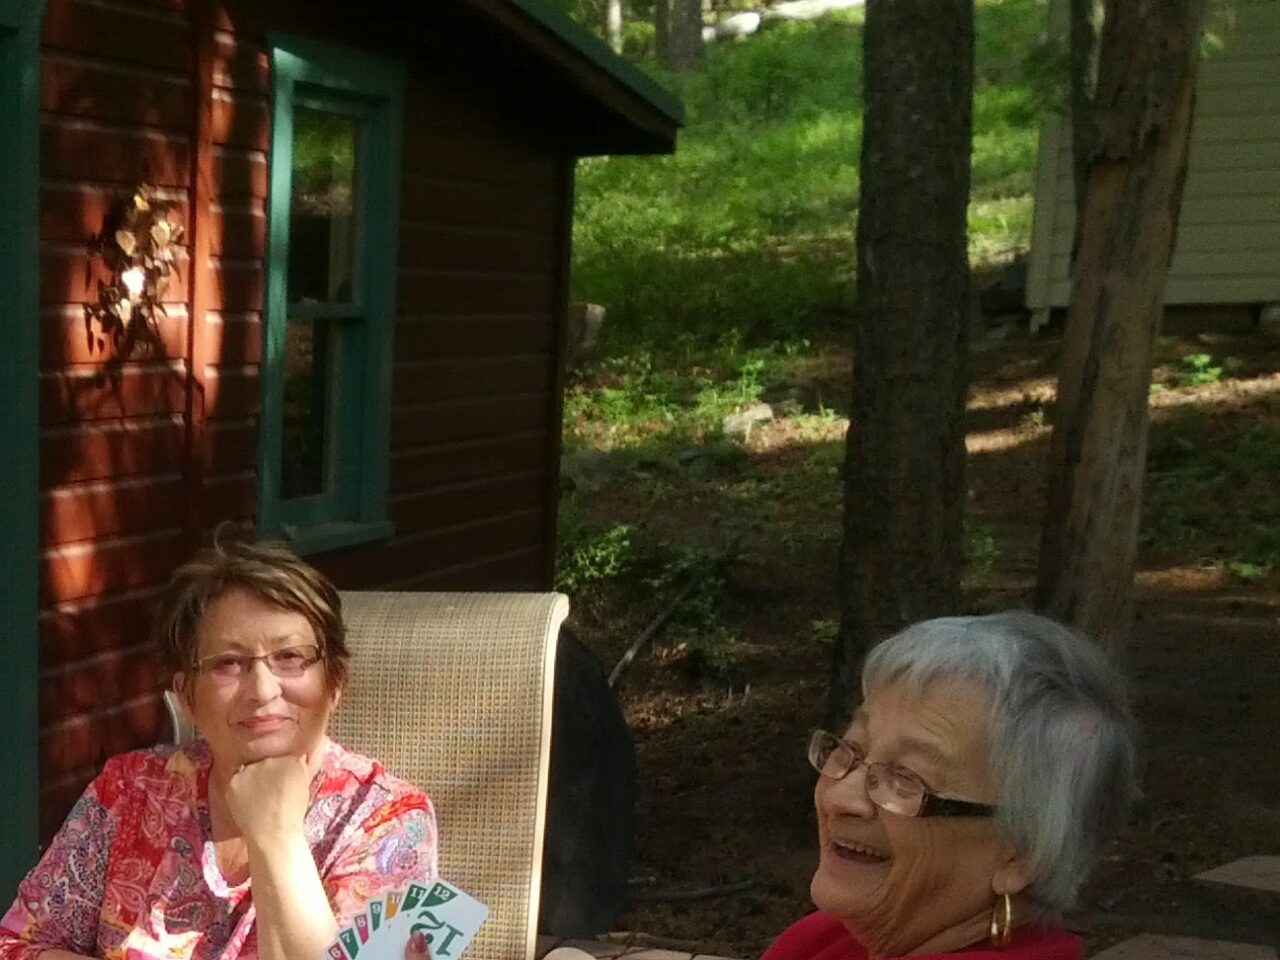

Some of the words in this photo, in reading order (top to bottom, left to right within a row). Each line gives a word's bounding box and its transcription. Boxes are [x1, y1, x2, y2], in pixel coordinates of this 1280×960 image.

[410, 887, 424, 899] 11
[433, 886, 451, 901] 12
[371, 902, 382, 915] 9
[356, 916, 366, 928] 8
[341, 933, 351, 944] 7
[410, 910, 464, 957] 12
[331, 947, 342, 959] 6
